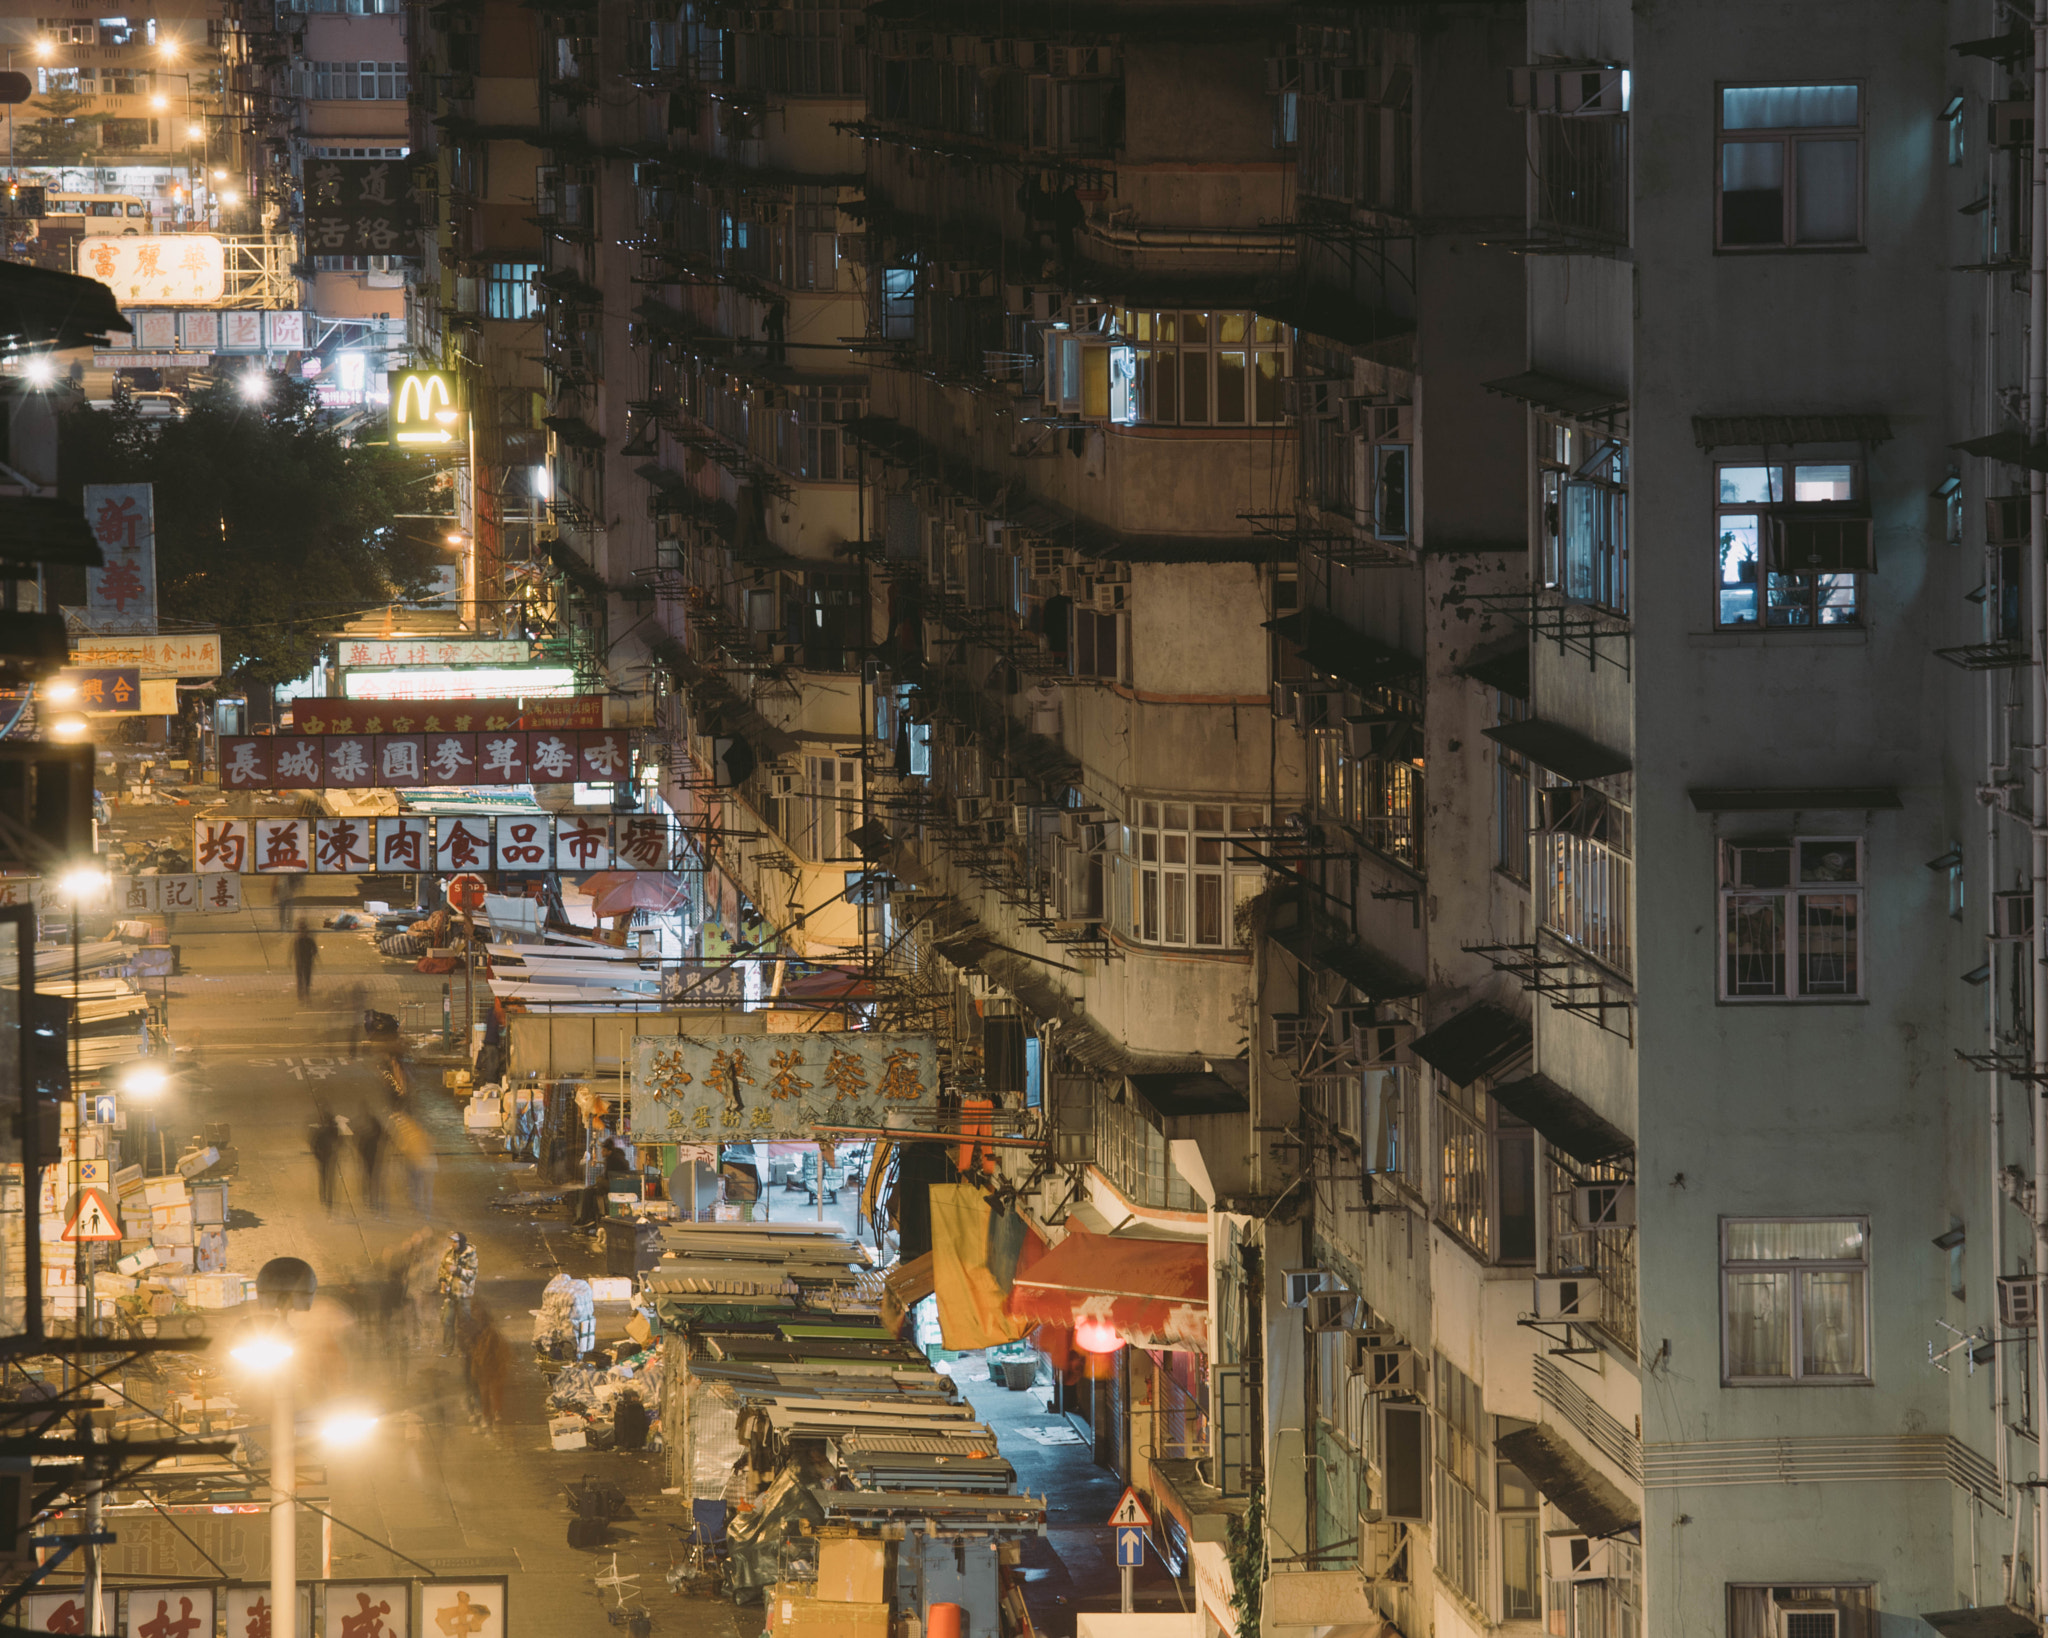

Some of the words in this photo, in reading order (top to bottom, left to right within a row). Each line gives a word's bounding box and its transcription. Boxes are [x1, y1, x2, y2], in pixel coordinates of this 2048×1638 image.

[90, 243, 211, 280] 富麗華
[140, 356, 168, 366] 2377
[95, 496, 145, 614] 新華
[199, 819, 667, 872] 均益凍肉食品市場
[454, 883, 480, 893] SOP
